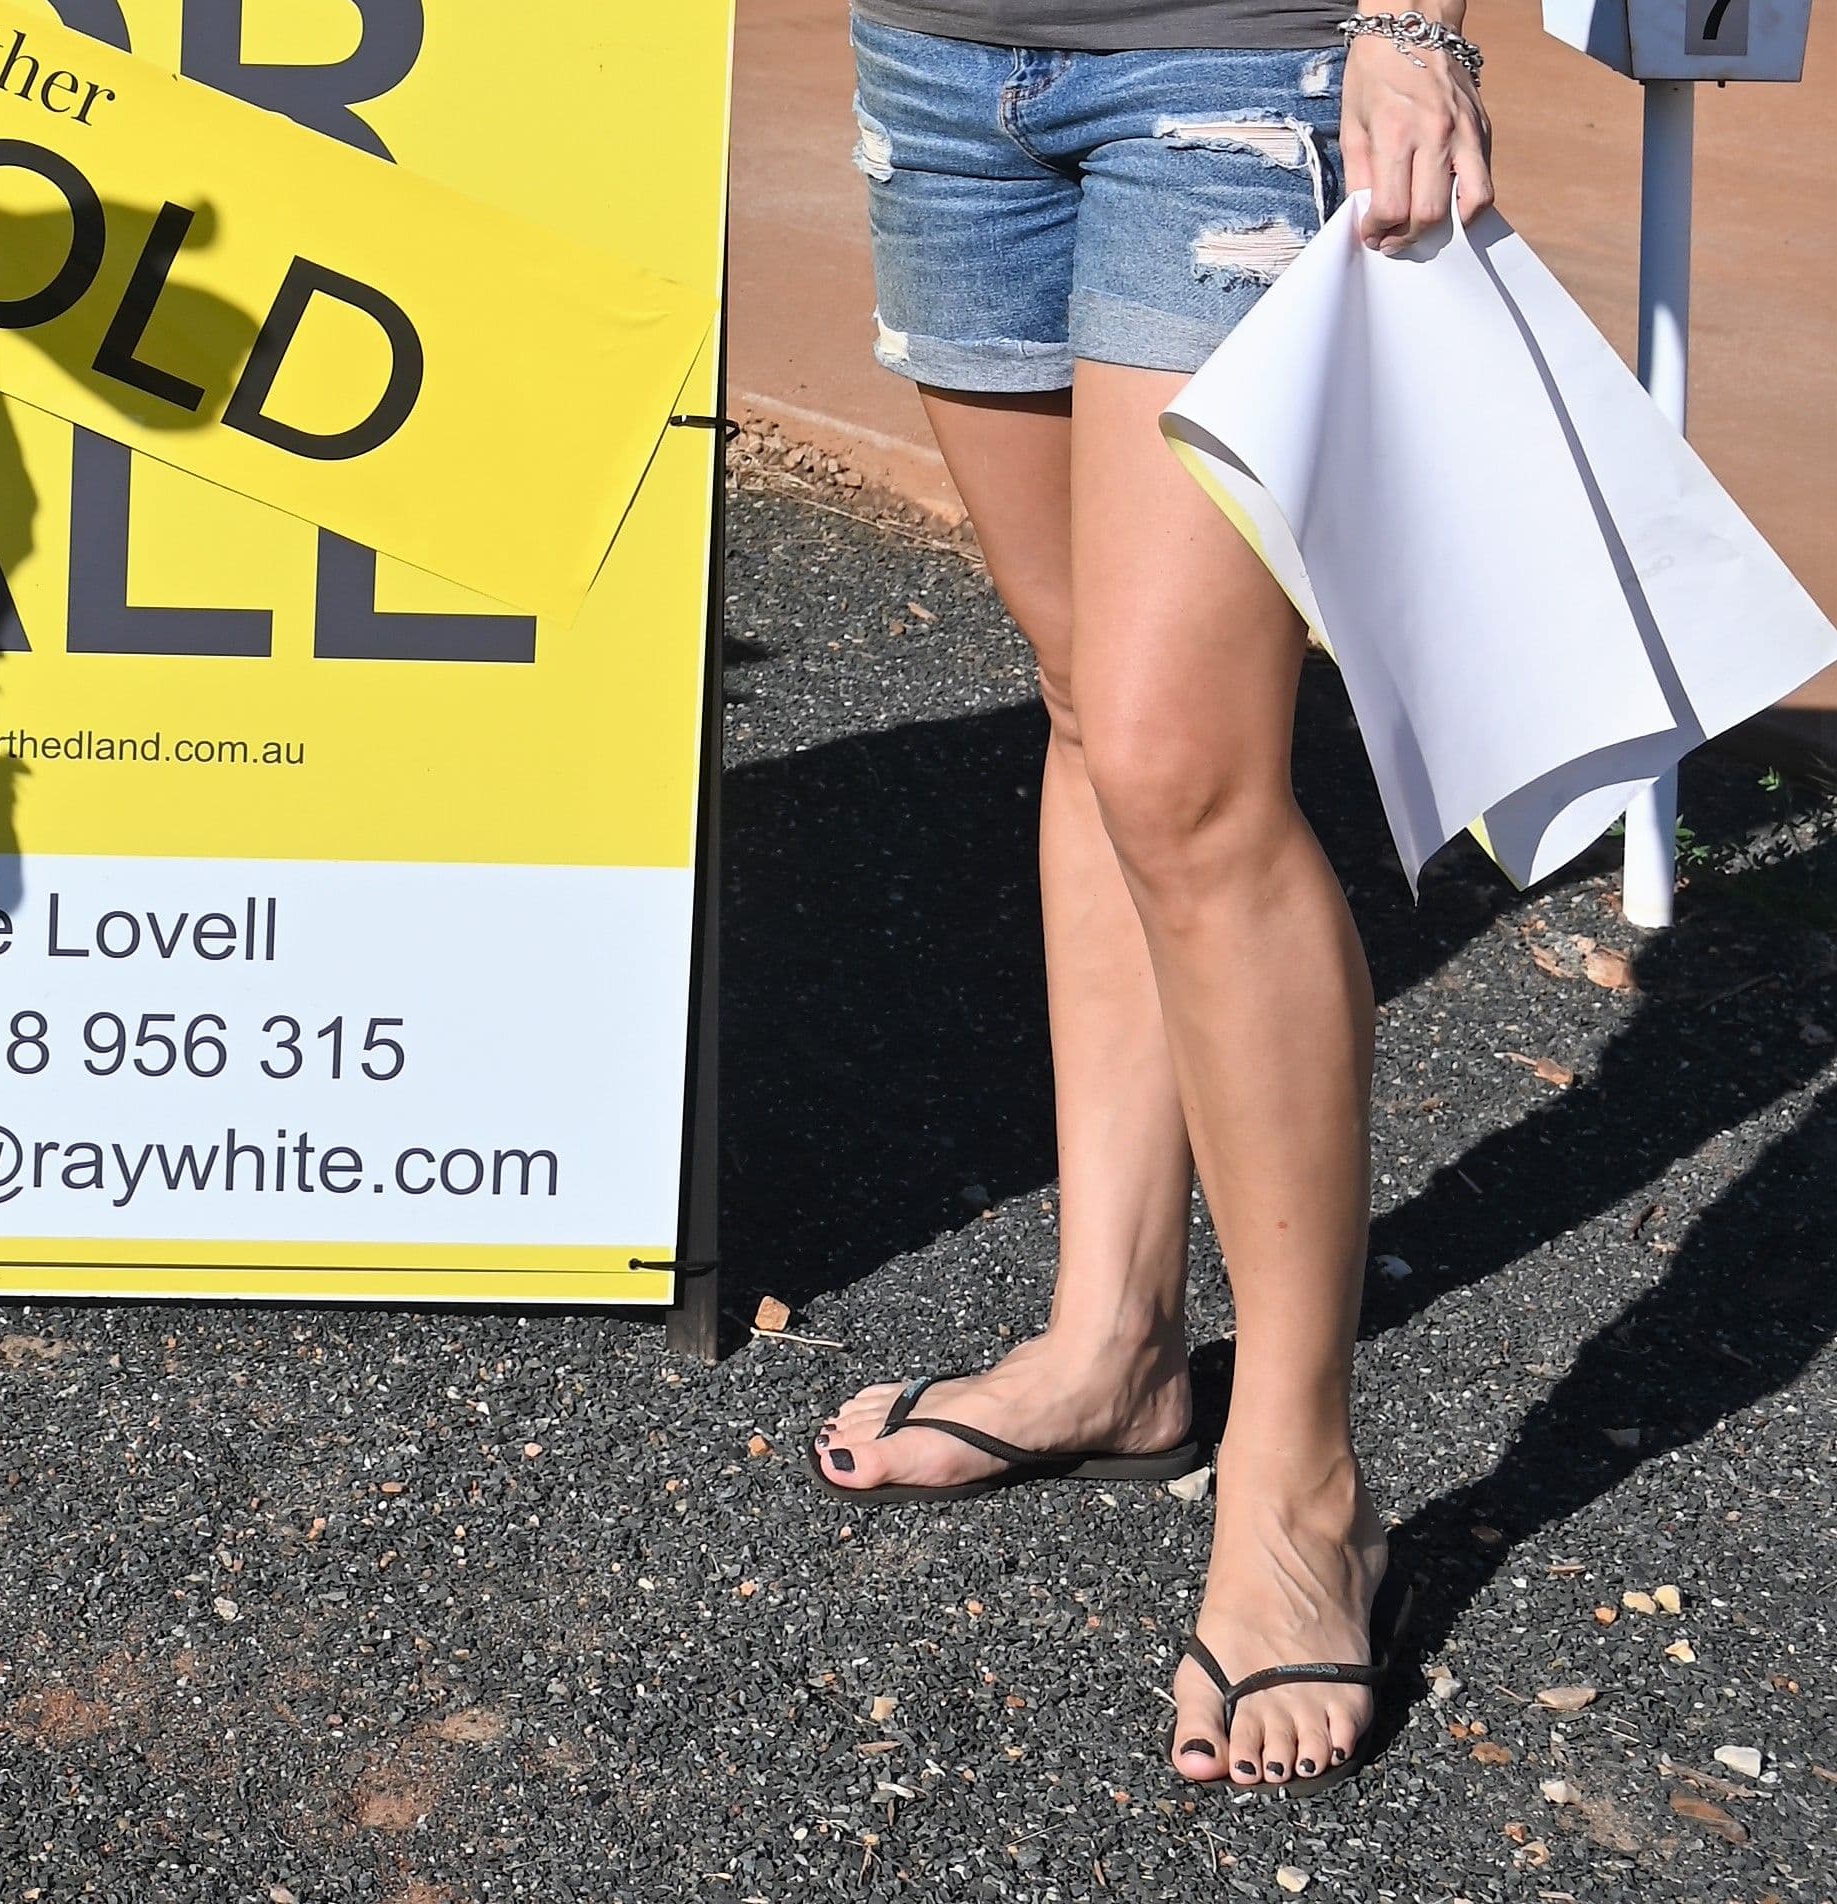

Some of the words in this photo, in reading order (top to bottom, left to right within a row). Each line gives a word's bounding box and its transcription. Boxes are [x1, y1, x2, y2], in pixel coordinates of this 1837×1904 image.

[48, 893, 276, 961] Lovell
[83, 1011, 227, 1078] 956
[260, 1015, 406, 1081] 315
